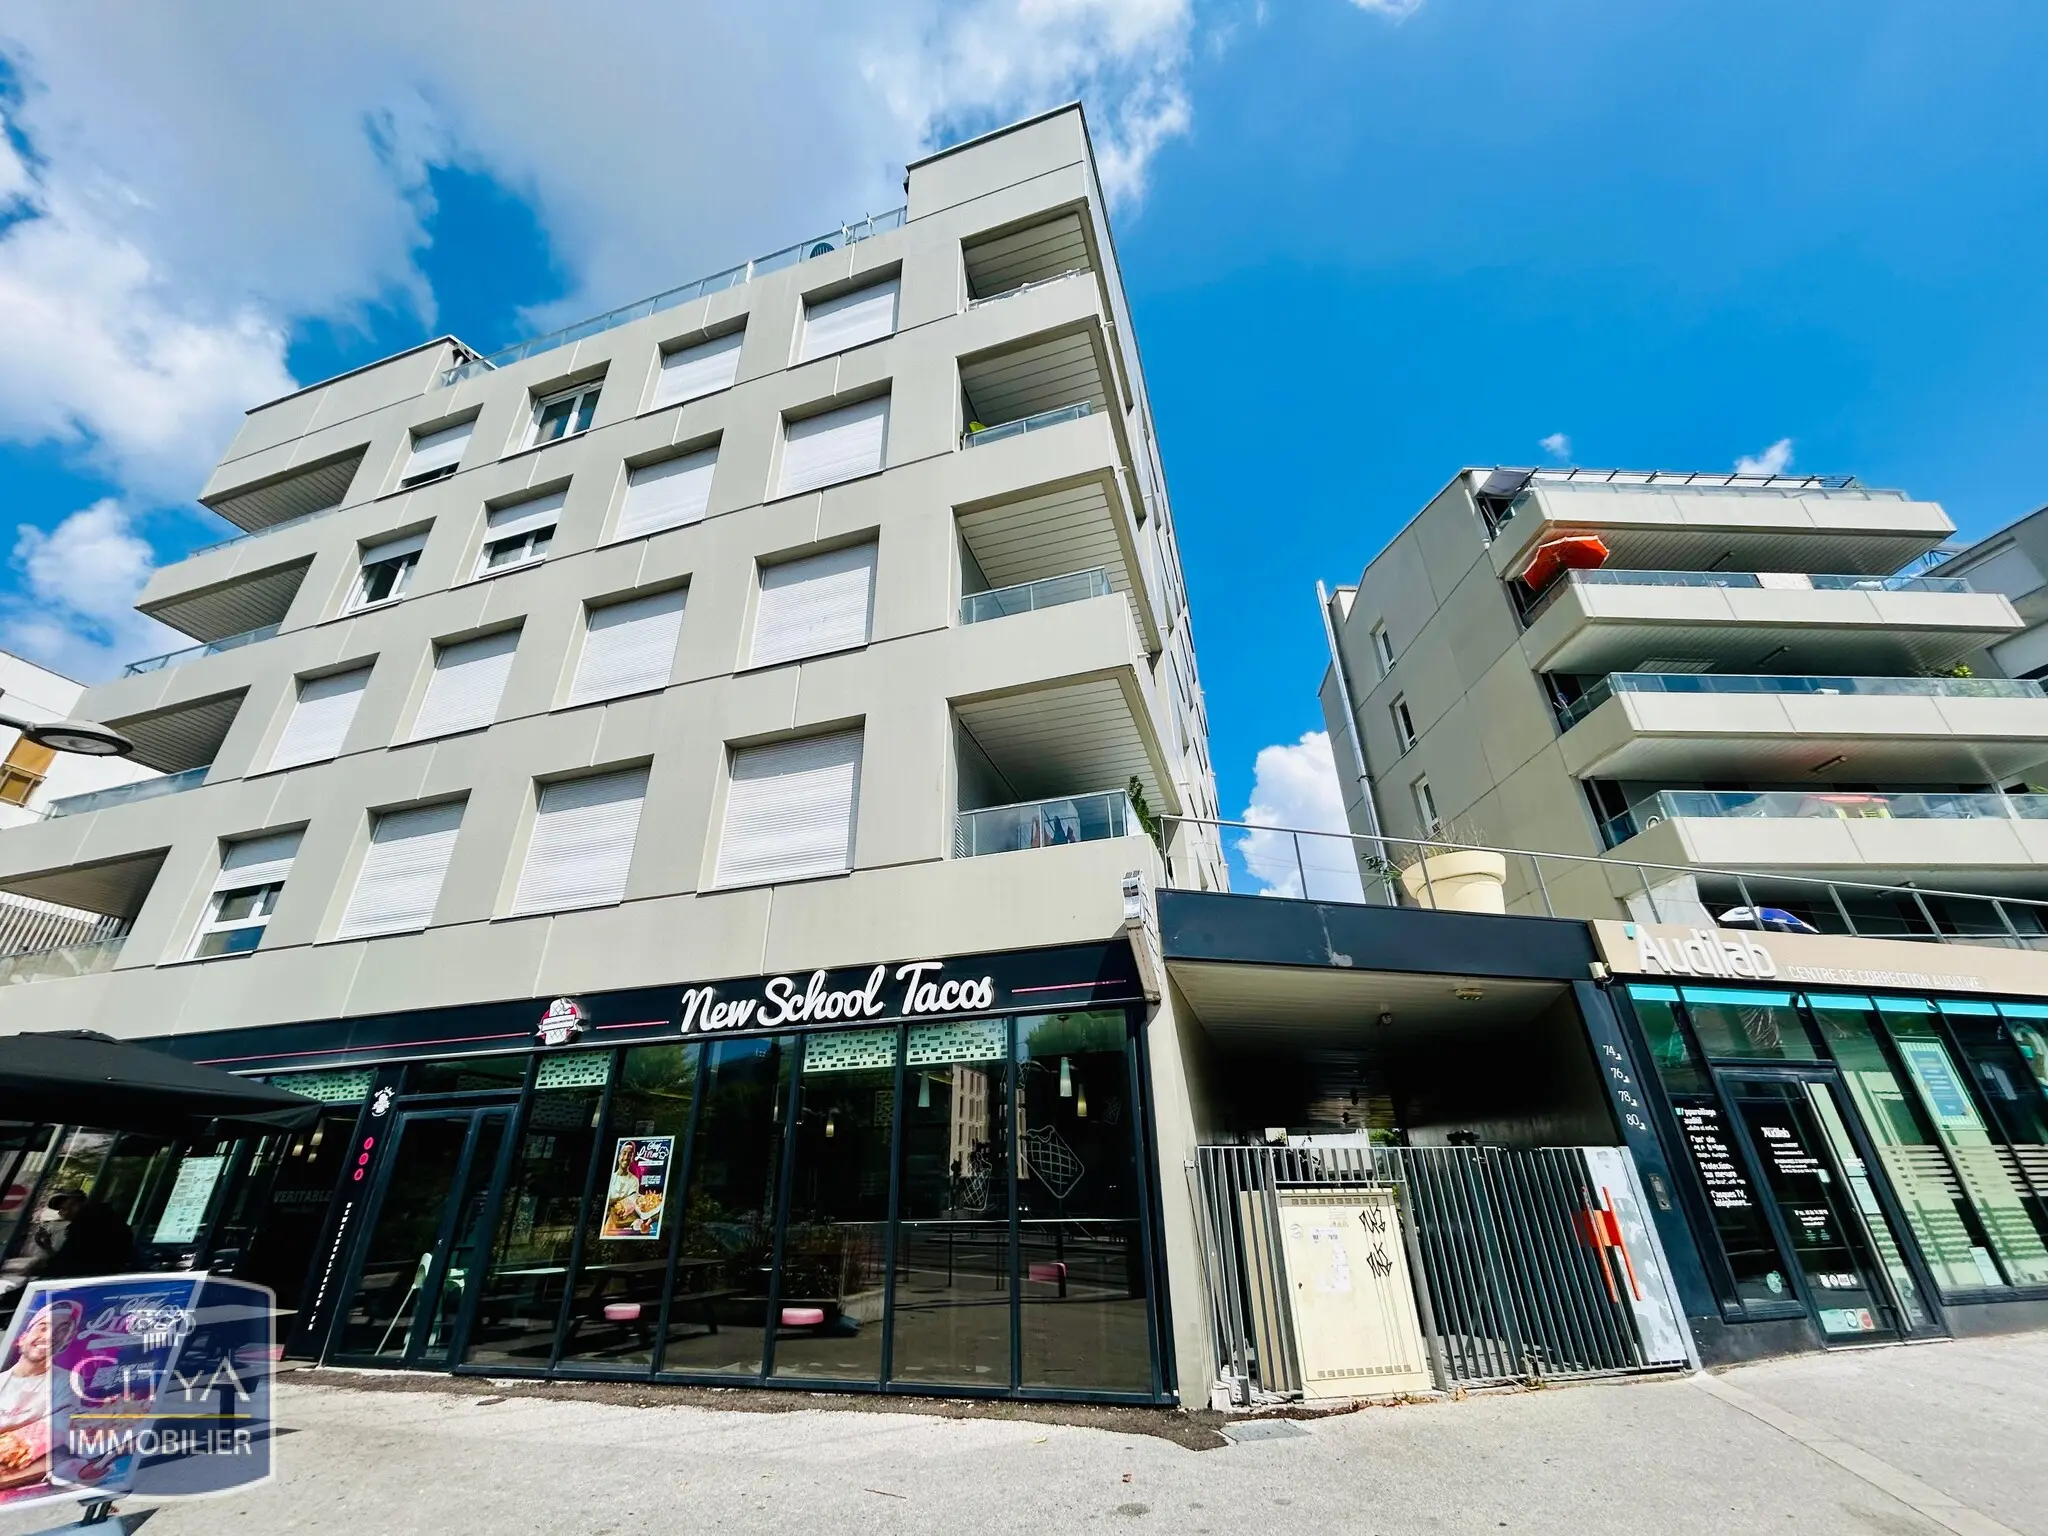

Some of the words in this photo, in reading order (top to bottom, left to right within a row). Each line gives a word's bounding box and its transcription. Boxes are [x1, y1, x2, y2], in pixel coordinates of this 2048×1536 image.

[1635, 923, 1777, 979] Audilab
[1788, 966, 1838, 981] CENTRE
[1839, 969, 1858, 983] DE
[1857, 970, 1930, 987] CORRECTION
[1931, 974, 1981, 989] AUDITIVE
[681, 986, 757, 1033] New
[756, 965, 886, 1027] School
[896, 961, 993, 1016] Tacos
[1603, 1044, 1616, 1056] 74
[1610, 1067, 1623, 1079] 76
[1618, 1090, 1631, 1102] 78
[1625, 1113, 1639, 1126] 80
